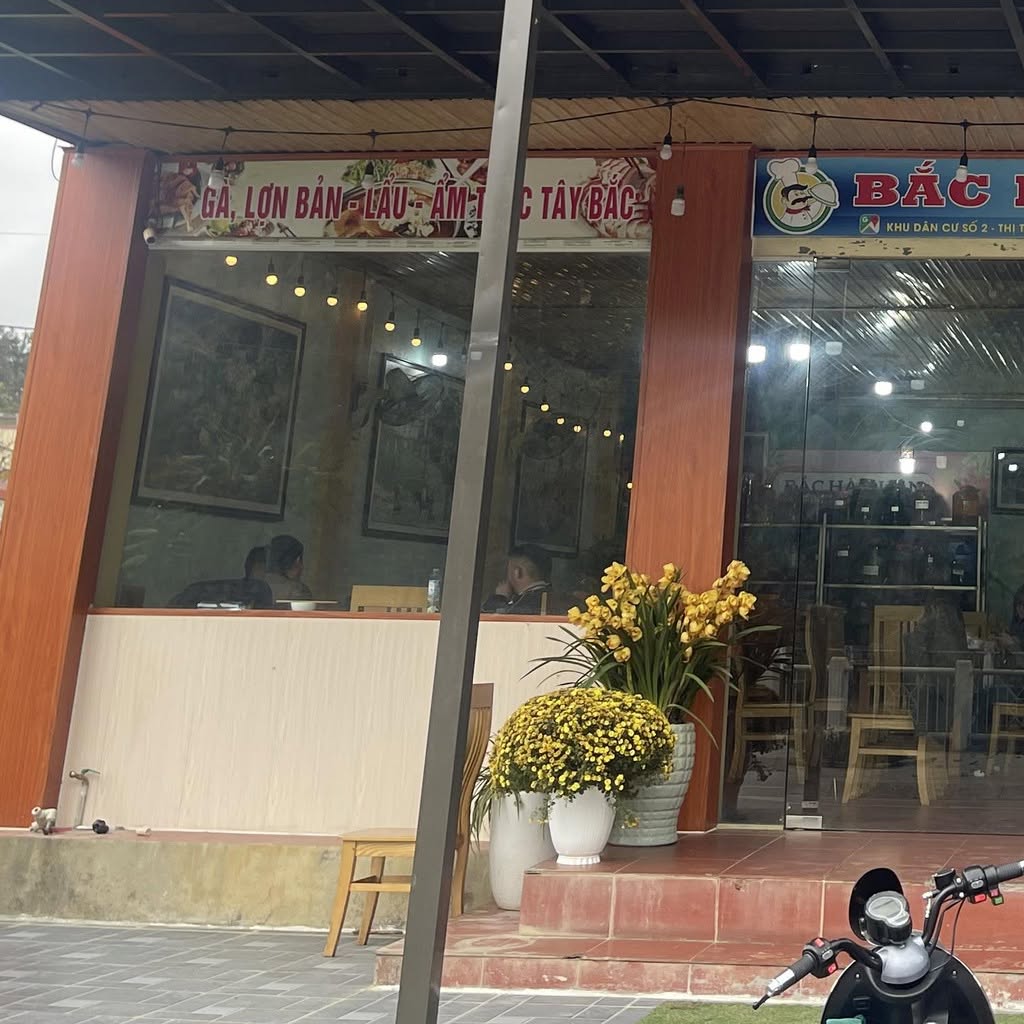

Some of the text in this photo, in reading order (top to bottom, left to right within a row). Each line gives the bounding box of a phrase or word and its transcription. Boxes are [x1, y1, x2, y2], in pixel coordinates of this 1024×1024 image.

[294, 174, 343, 220] BẢN
[363, 172, 409, 220] LẨU
[429, 172, 468, 220] ẨM
[475, 184, 533, 220] TC
[541, 179, 582, 220] TÂY
[588, 173, 635, 220] BẮC
[852, 160, 992, 208] BẮC
[886, 222, 910, 233] KHU
[914, 219, 938, 233] DÂN
[942, 221, 959, 233] CƯ
[962, 219, 978, 233] SỐ
[981, 223, 988, 233] 2
